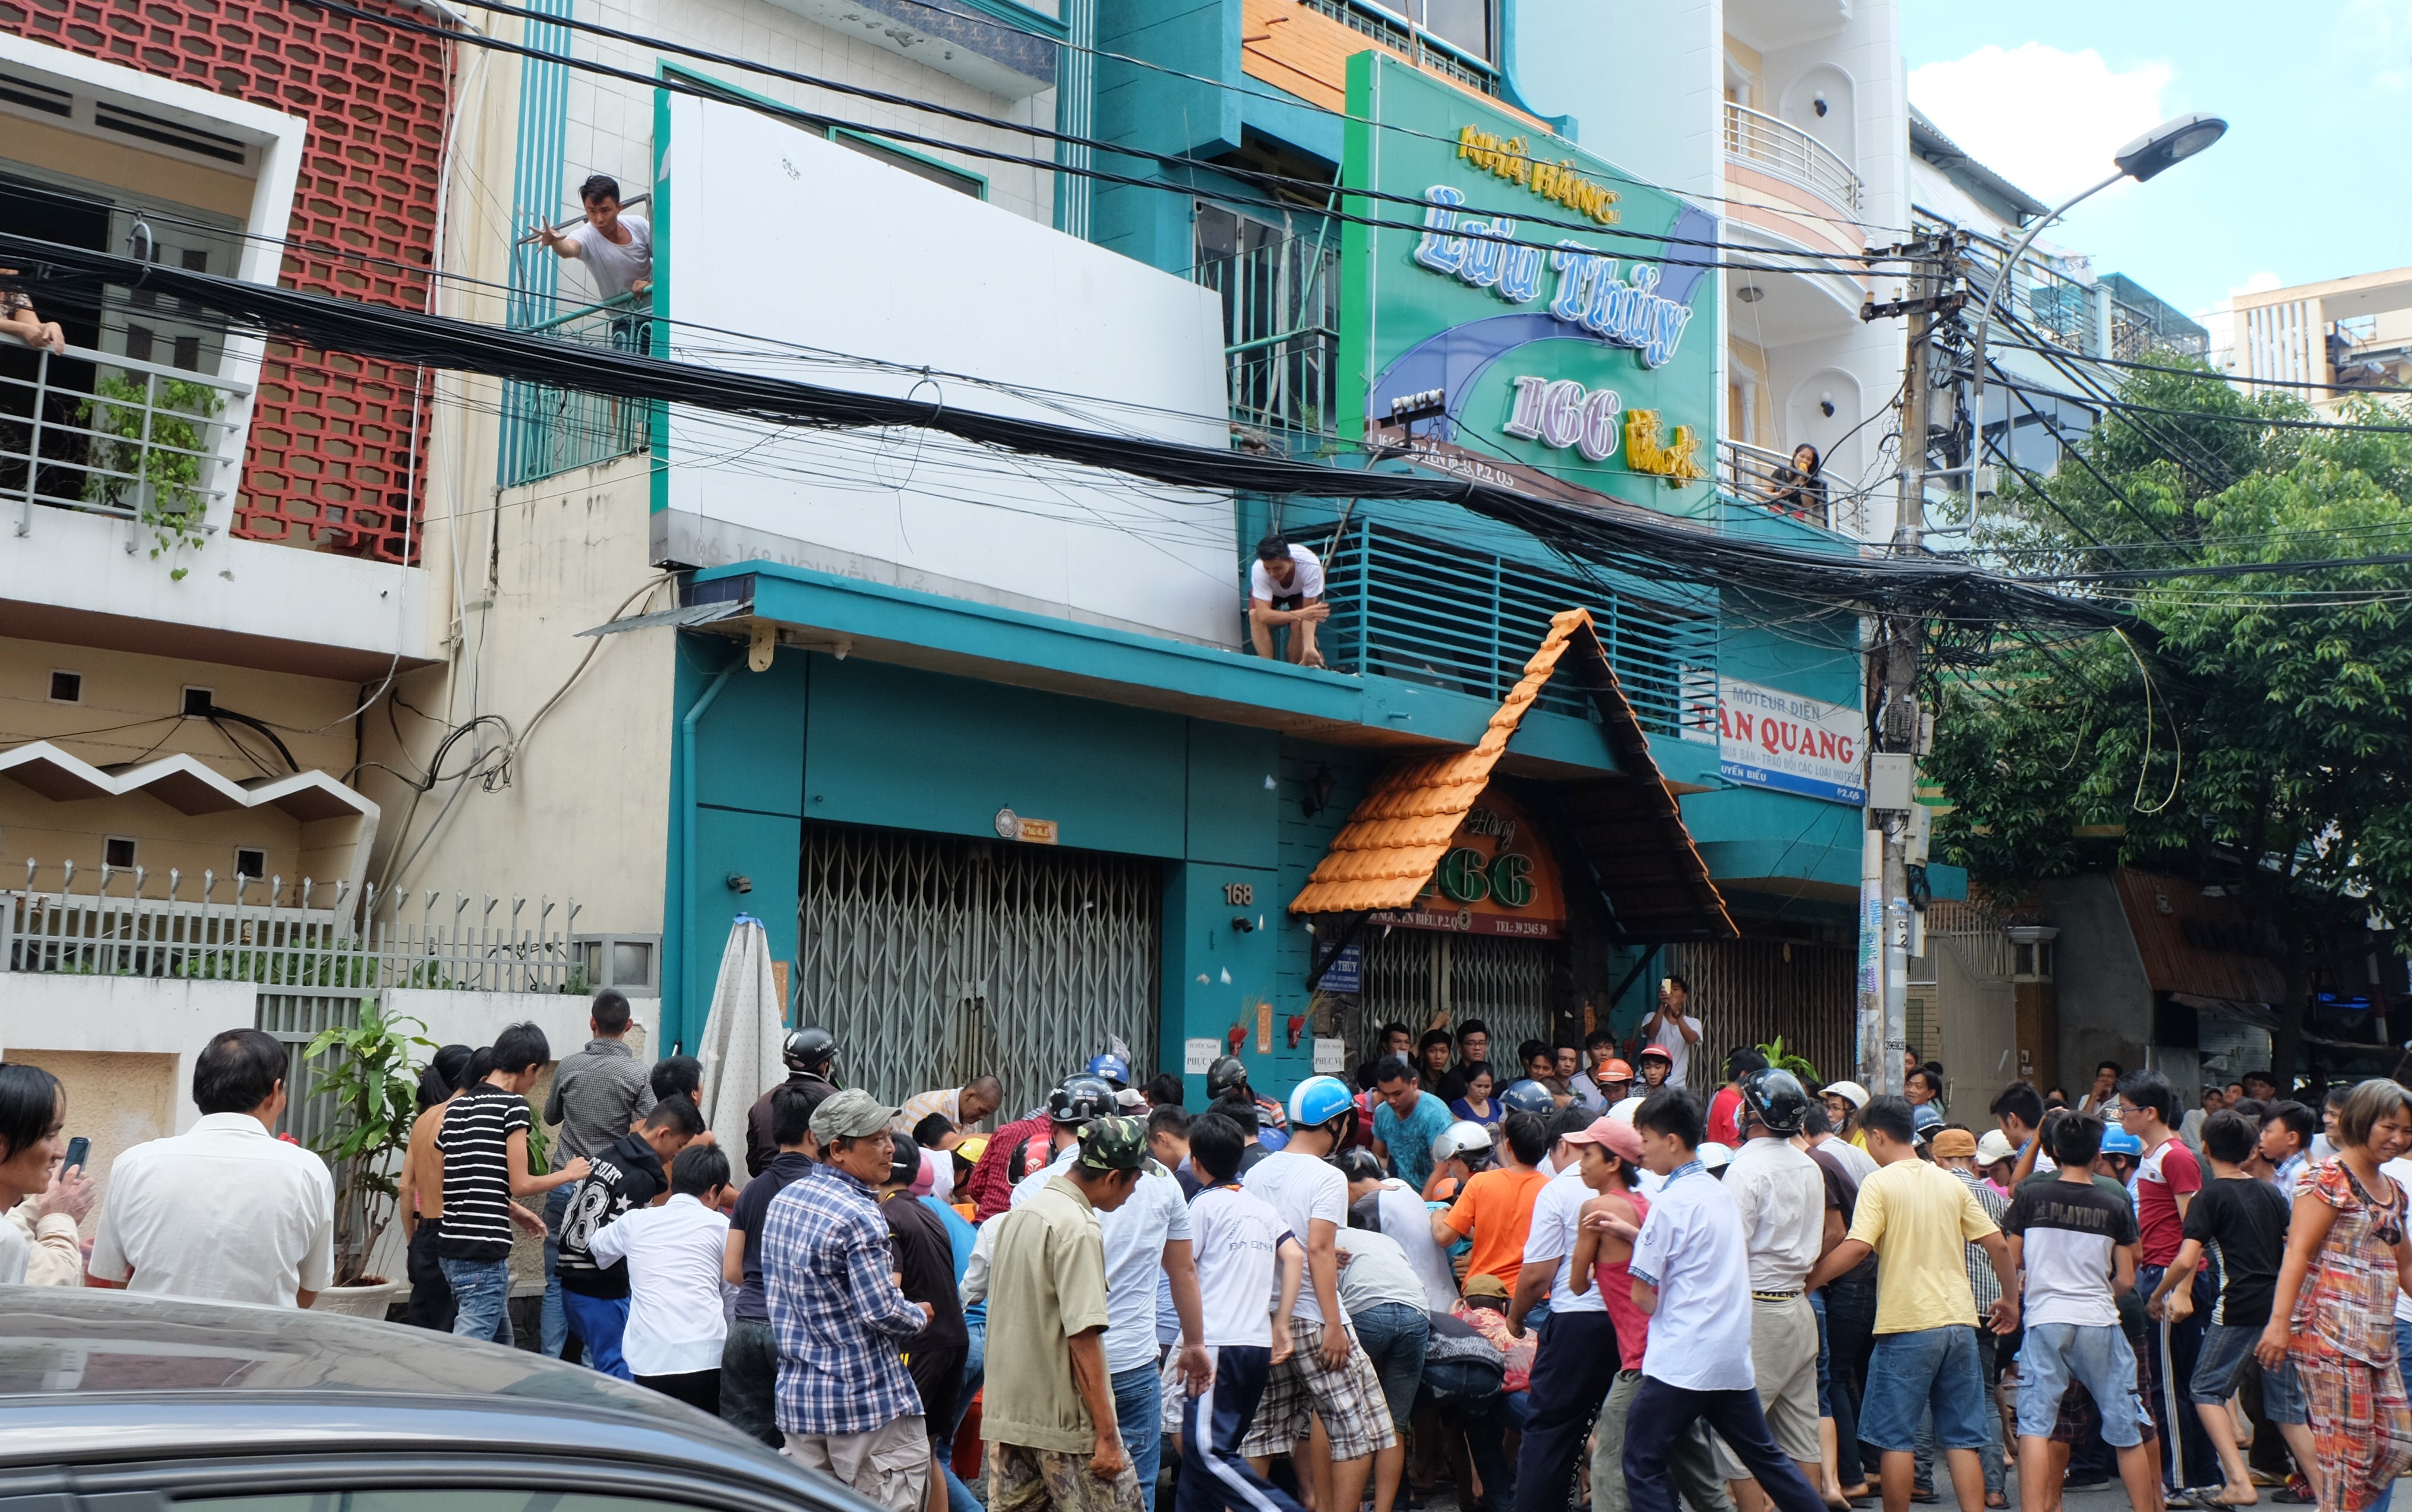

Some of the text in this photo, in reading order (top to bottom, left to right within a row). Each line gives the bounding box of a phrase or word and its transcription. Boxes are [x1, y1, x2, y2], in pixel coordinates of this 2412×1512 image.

[1503, 375, 1623, 462] 166
[1733, 687, 1785, 713] MOTEUR
[1761, 717, 1854, 764] QUANG
[1762, 754, 1782, 767] TRAO
[1224, 883, 1253, 905] 168
[1496, 921, 1513, 933] TEL:
[2049, 1201, 2109, 1229] PLAYBOY
